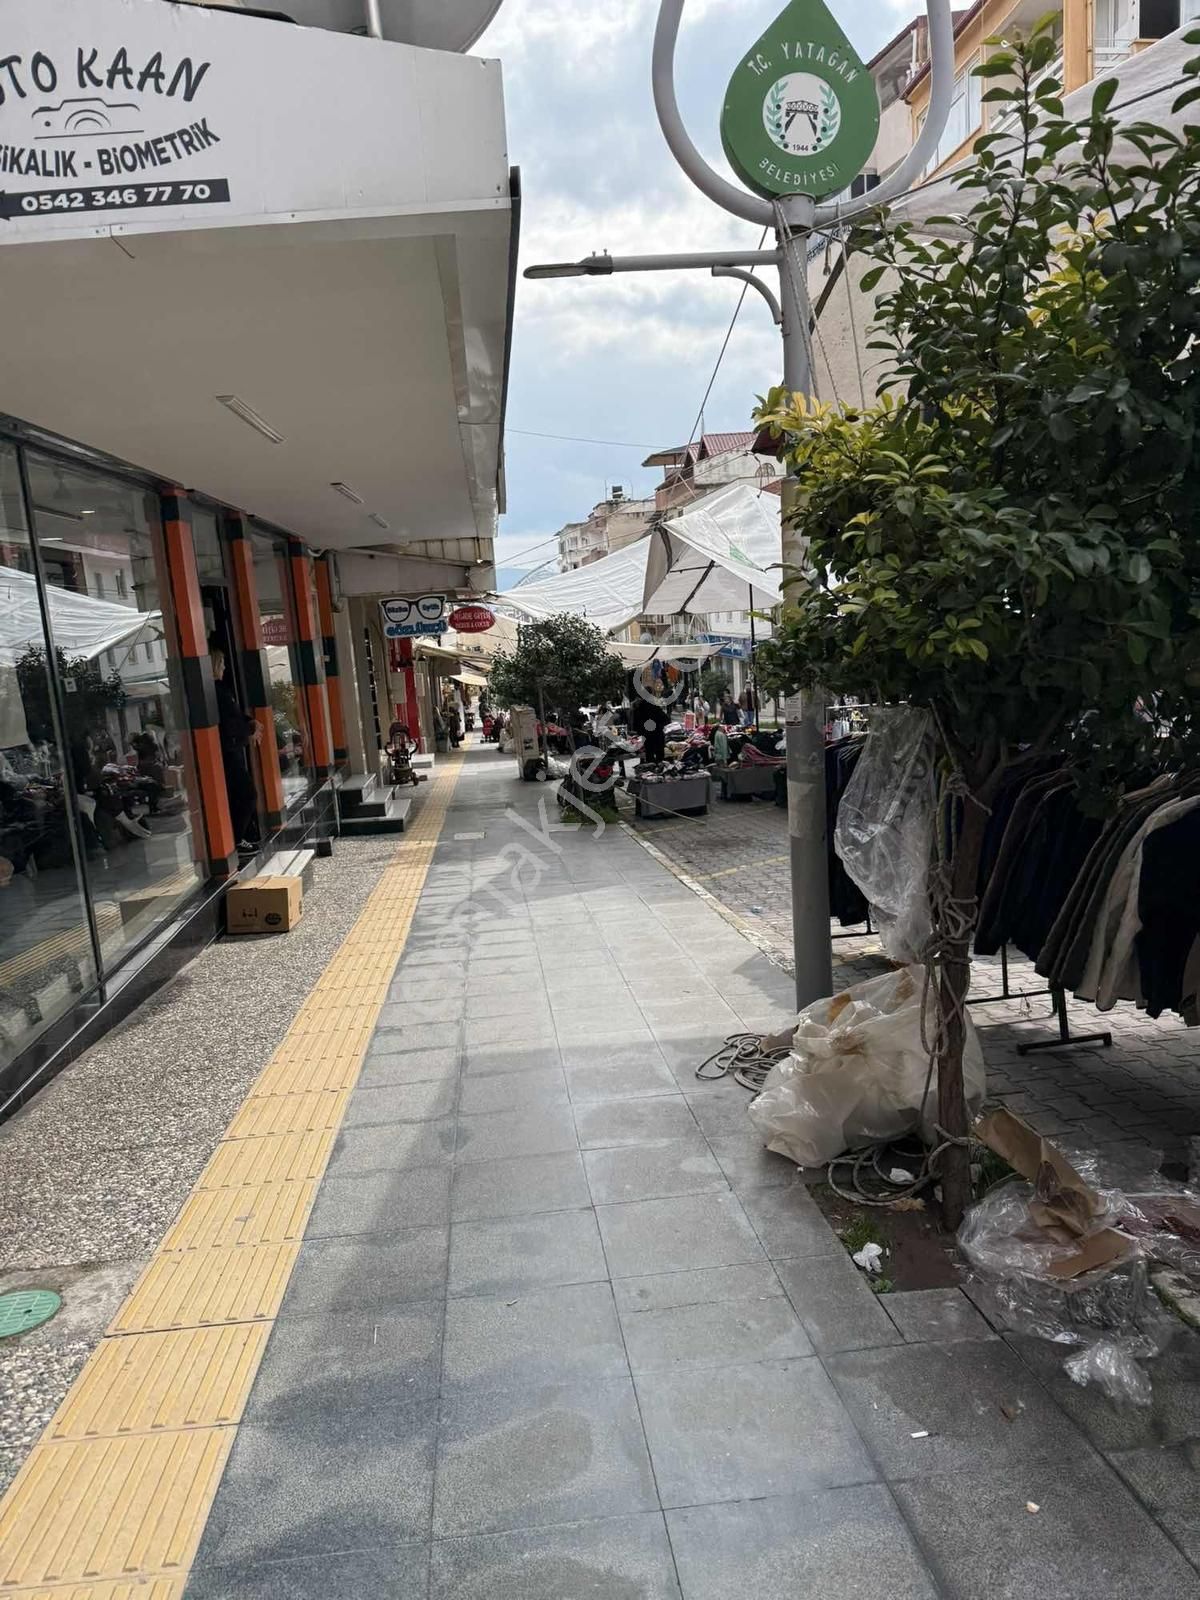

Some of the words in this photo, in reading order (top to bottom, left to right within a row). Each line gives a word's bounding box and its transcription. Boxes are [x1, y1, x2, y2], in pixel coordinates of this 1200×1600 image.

[0, 51, 57, 105] TO
[77, 46, 212, 102] KAAN
[747, 53, 772, 77] T.C.
[97, 117, 221, 176] BİOMETRİK
[792, 143, 809, 152] 1944
[21, 194, 85, 212] 0542
[91, 188, 138, 206] 346
[144, 186, 172, 203] 77
[179, 183, 211, 200] 70
